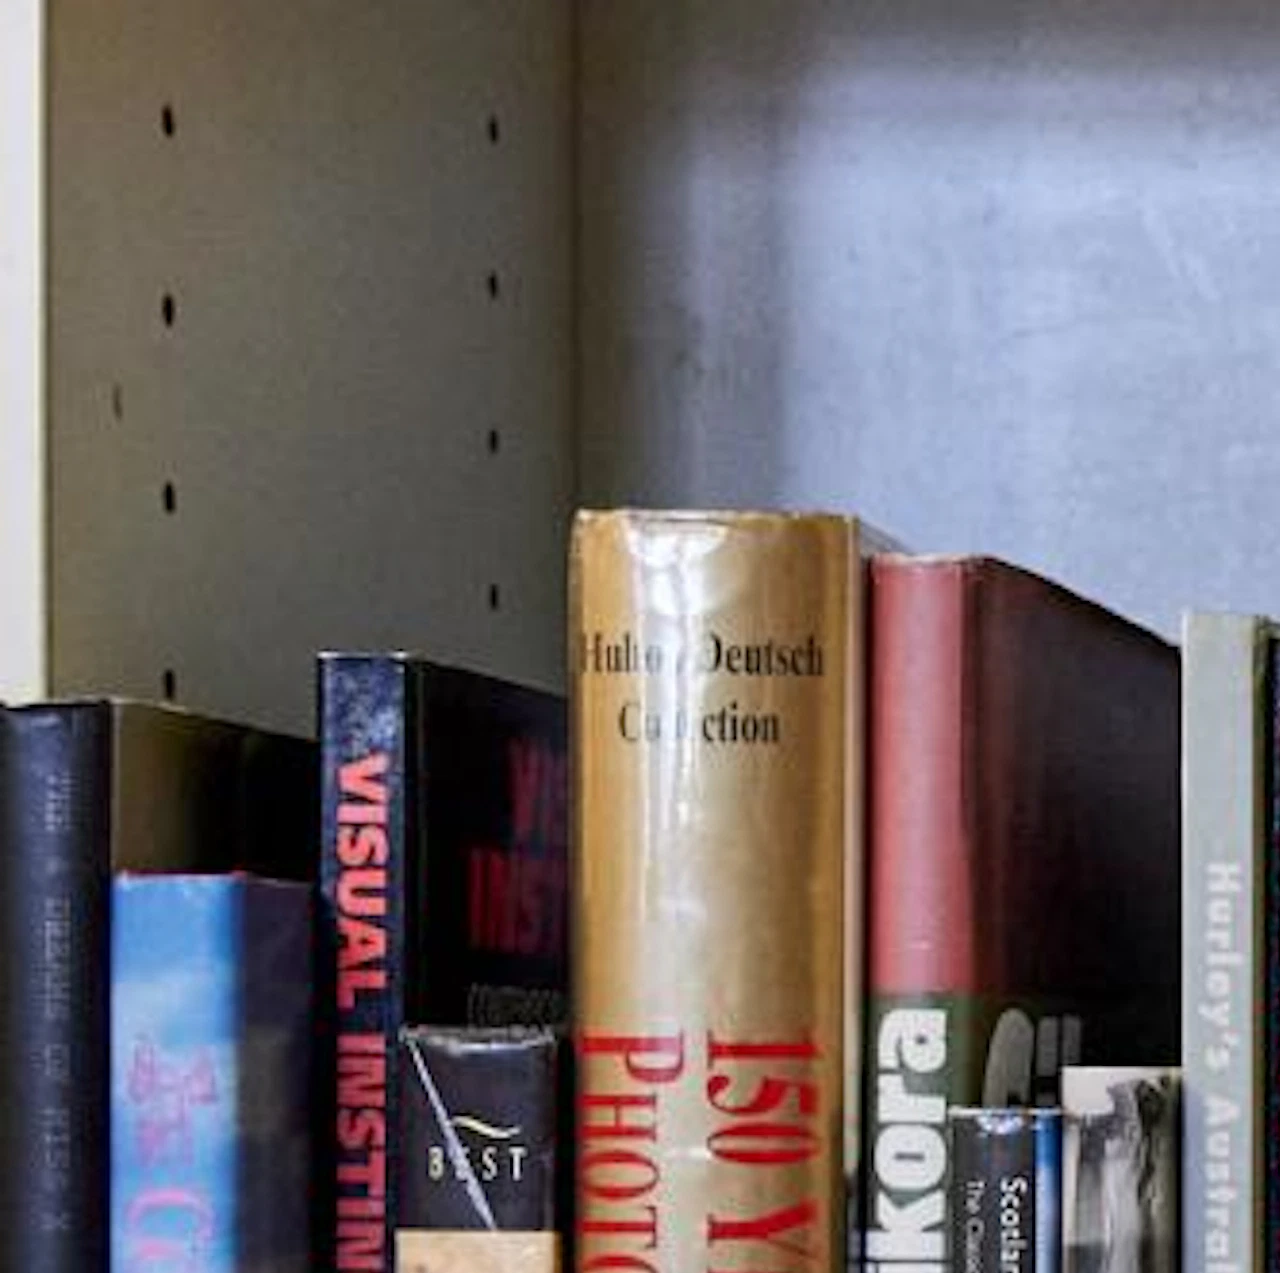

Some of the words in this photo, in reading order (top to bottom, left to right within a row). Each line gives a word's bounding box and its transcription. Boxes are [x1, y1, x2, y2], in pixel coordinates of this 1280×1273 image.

[333, 752, 391, 1009] VISUAL
[1202, 862, 1244, 1072] Hurley's
[704, 1029, 822, 1164] 150
